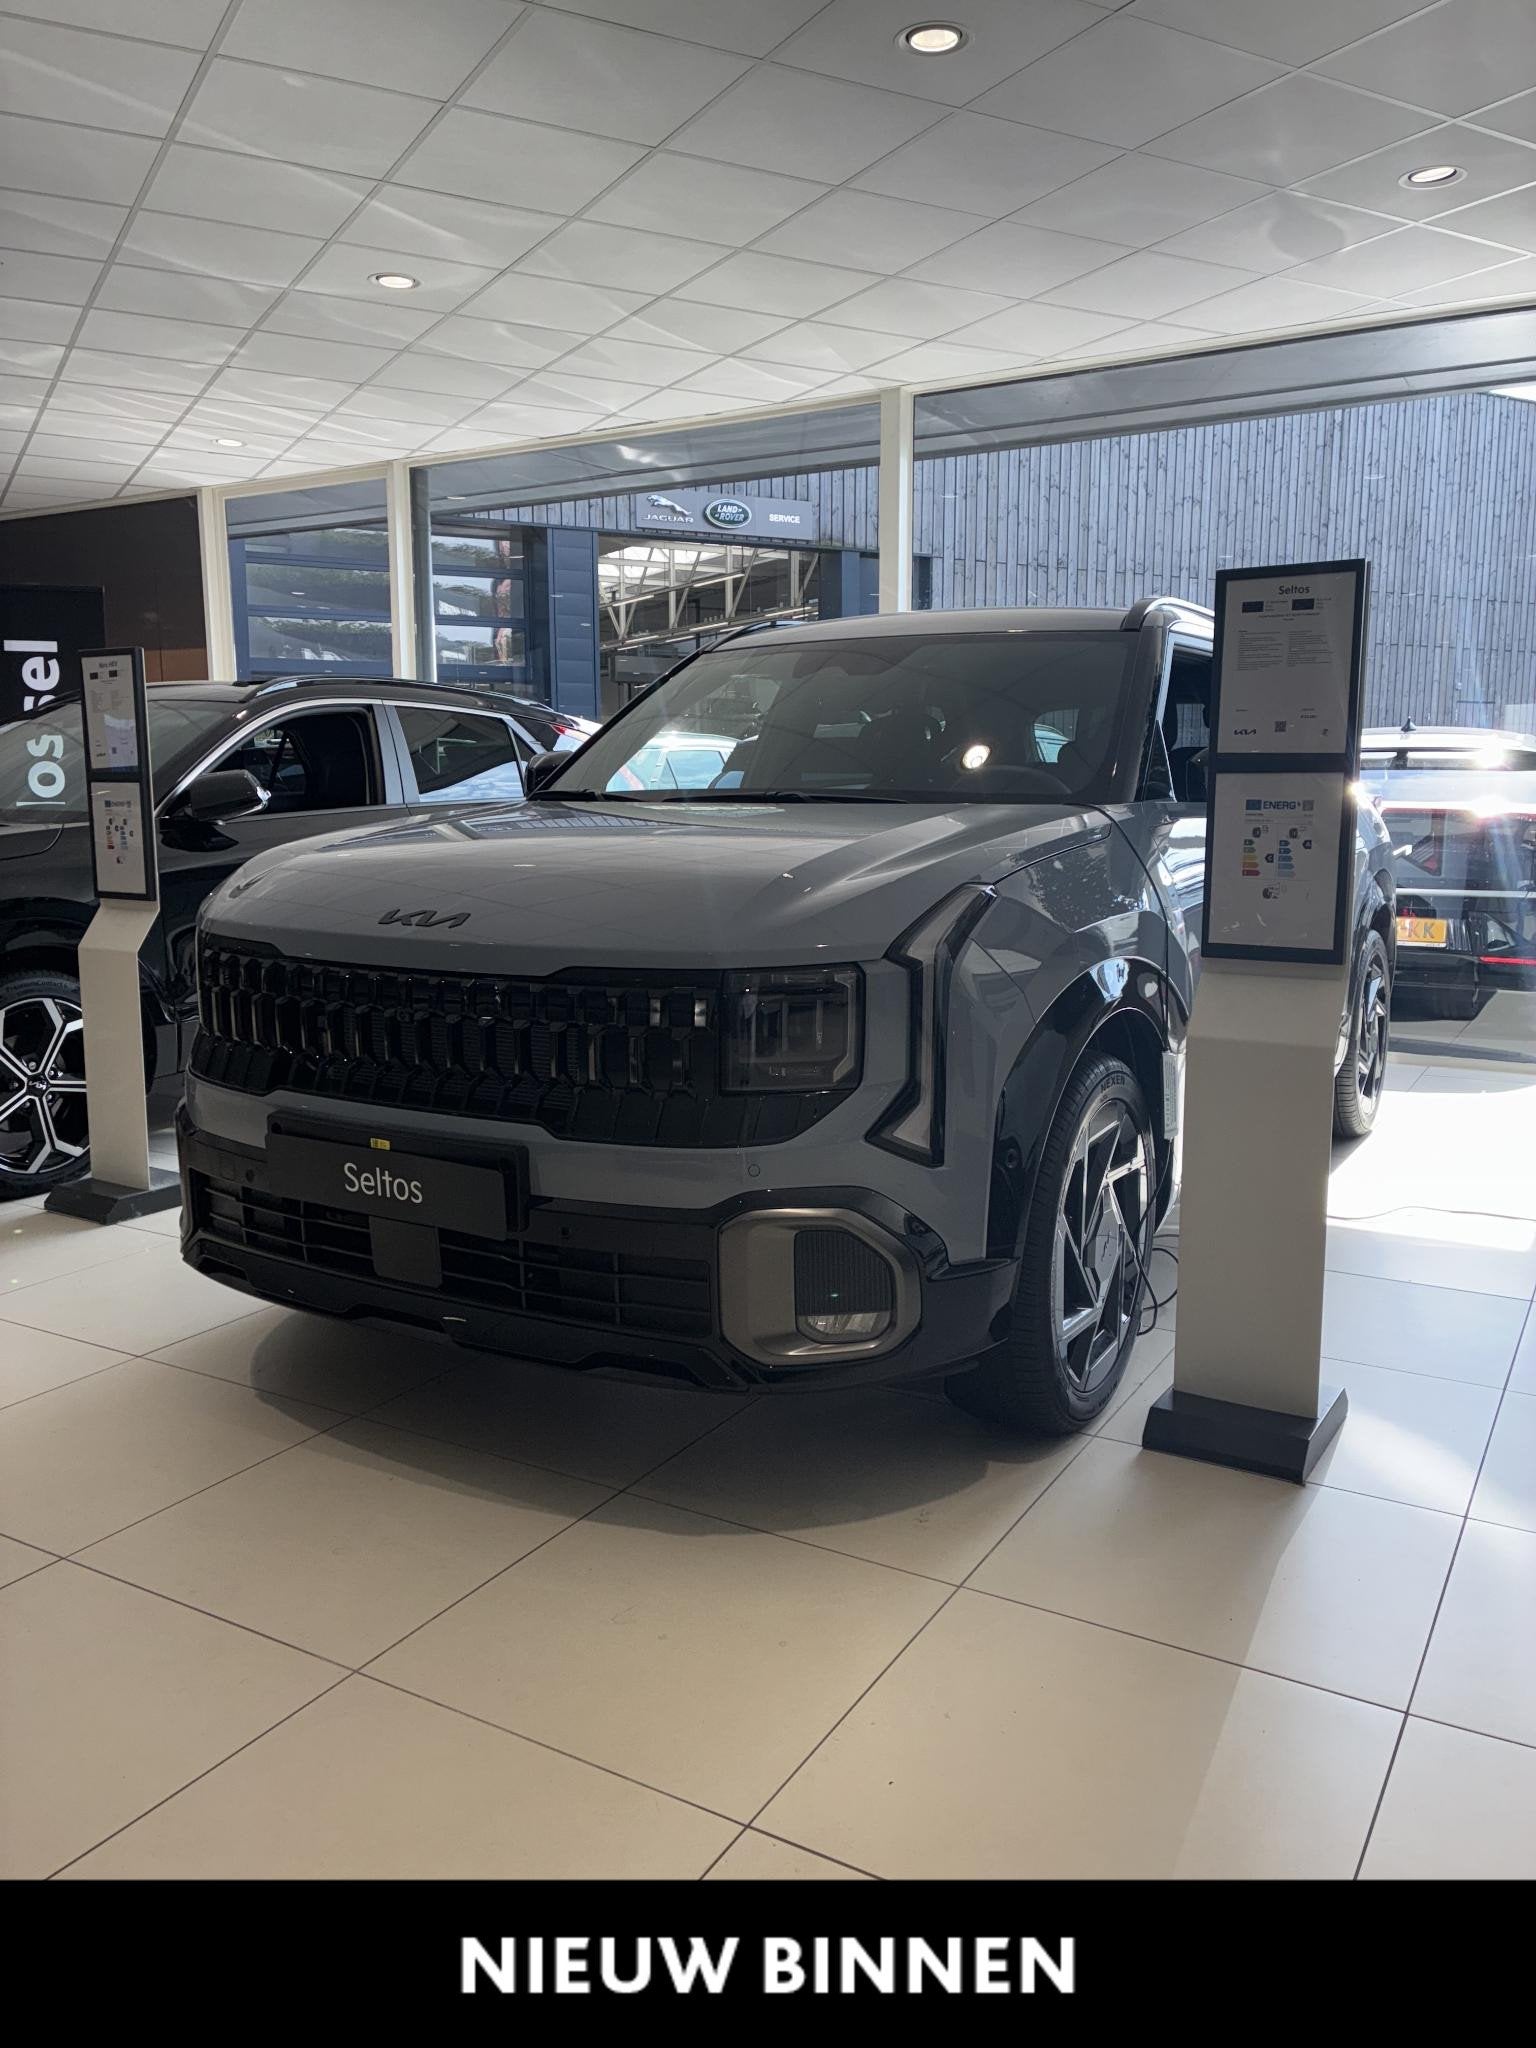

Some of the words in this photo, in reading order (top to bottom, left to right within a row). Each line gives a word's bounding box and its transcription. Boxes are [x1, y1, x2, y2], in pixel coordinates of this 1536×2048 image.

[717, 504, 738, 514] LAND
[643, 514, 694, 523] JAGUAR
[719, 512, 744, 522] ROVER
[769, 513, 800, 524] SERVICE
[1278, 585, 1310, 595] Seltos
[1100, 1073, 1126, 1094] NEXEN
[343, 1162, 423, 1204] Seltos
